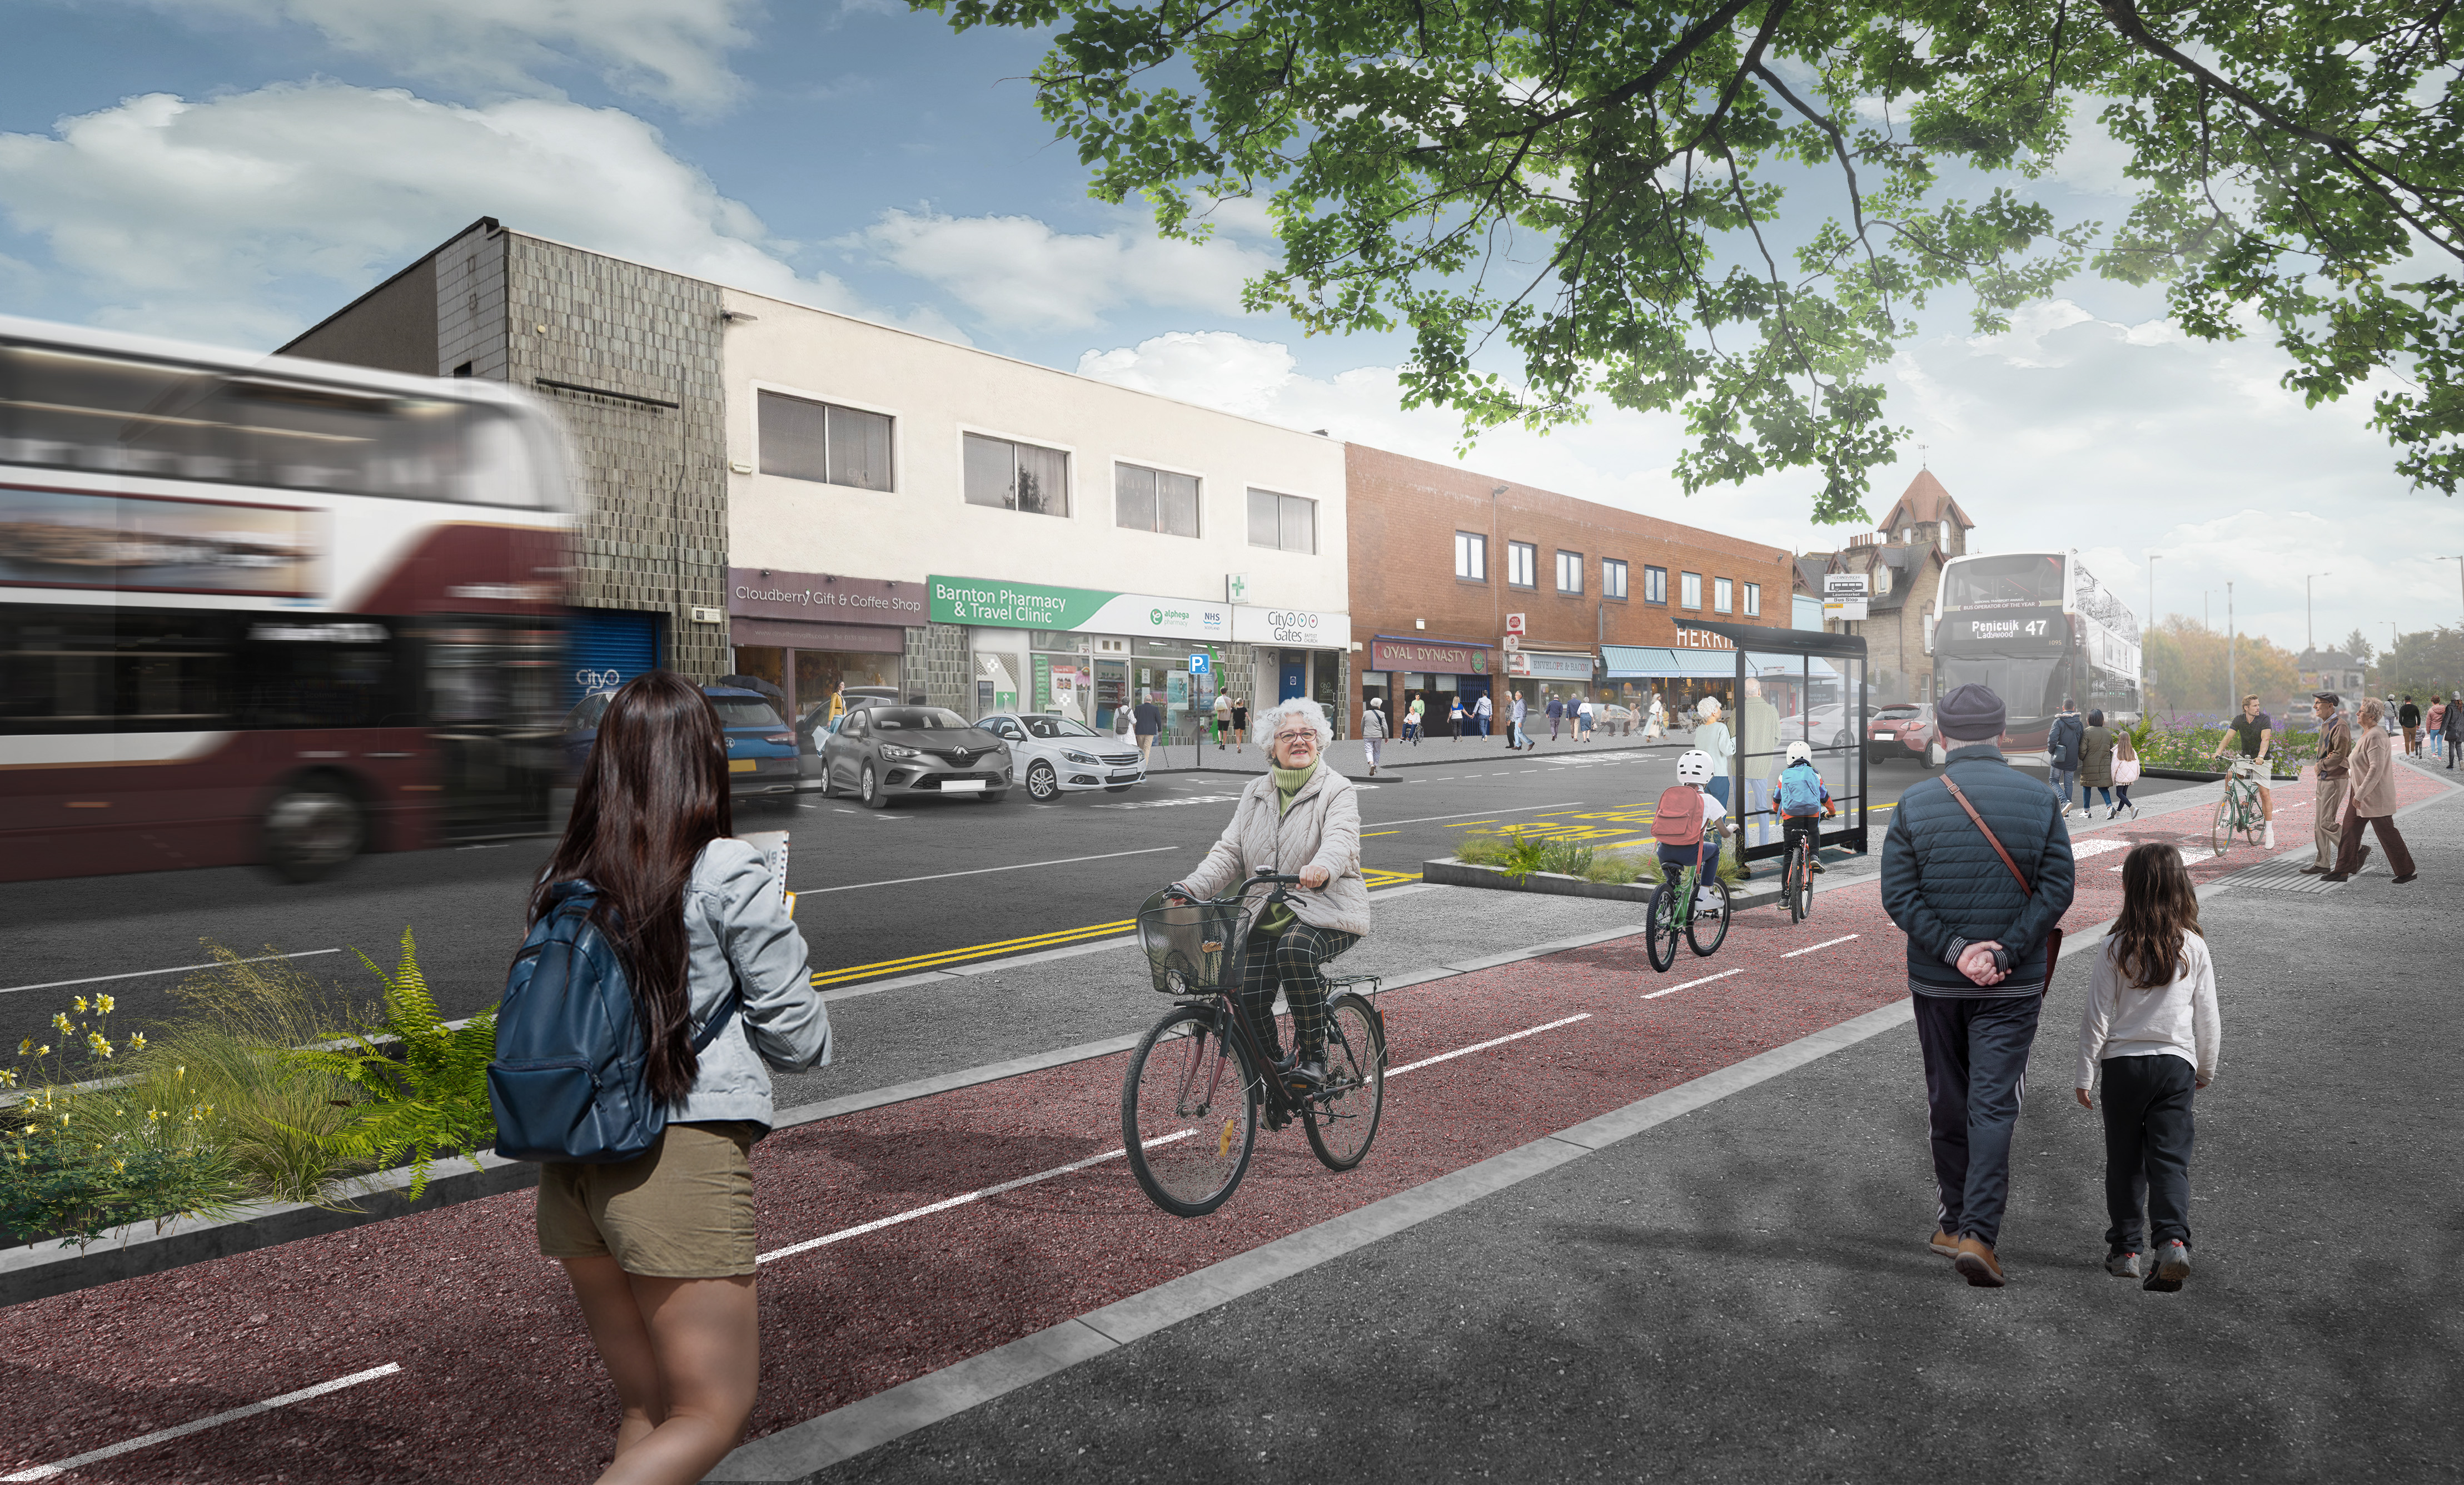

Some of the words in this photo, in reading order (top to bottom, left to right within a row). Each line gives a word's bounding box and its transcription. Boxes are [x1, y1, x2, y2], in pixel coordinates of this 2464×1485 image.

[735, 585, 810, 606] Cloudberry
[813, 592, 835, 605] Gift
[839, 593, 847, 606] &
[850, 594, 889, 609] Coffee
[892, 598, 920, 613] Shop
[936, 584, 995, 604] Barnton
[1000, 589, 1066, 613] Pharmacy
[954, 601, 966, 617] &
[970, 603, 1012, 620] Travel
[1016, 607, 1052, 623] Clinic
[1164, 610, 1189, 620] alphega
[1204, 612, 1220, 621] NHS
[1164, 618, 1188, 627] pharmacy
[1268, 611, 1288, 630] City
[1972, 619, 2019, 632] Penicuik
[2025, 620, 2047, 635] 47
[1274, 627, 1302, 642] Gates
[1977, 630, 2013, 639] Ladywood
[1375, 644, 1412, 660] ROYAL
[1417, 648, 1467, 663] DYNASTY
[1192, 656, 1203, 672] P
[1534, 660, 1564, 671] ENVELOPE
[1565, 662, 1569, 671] &
[1571, 663, 1589, 672] BACON
[576, 669, 607, 689] City
